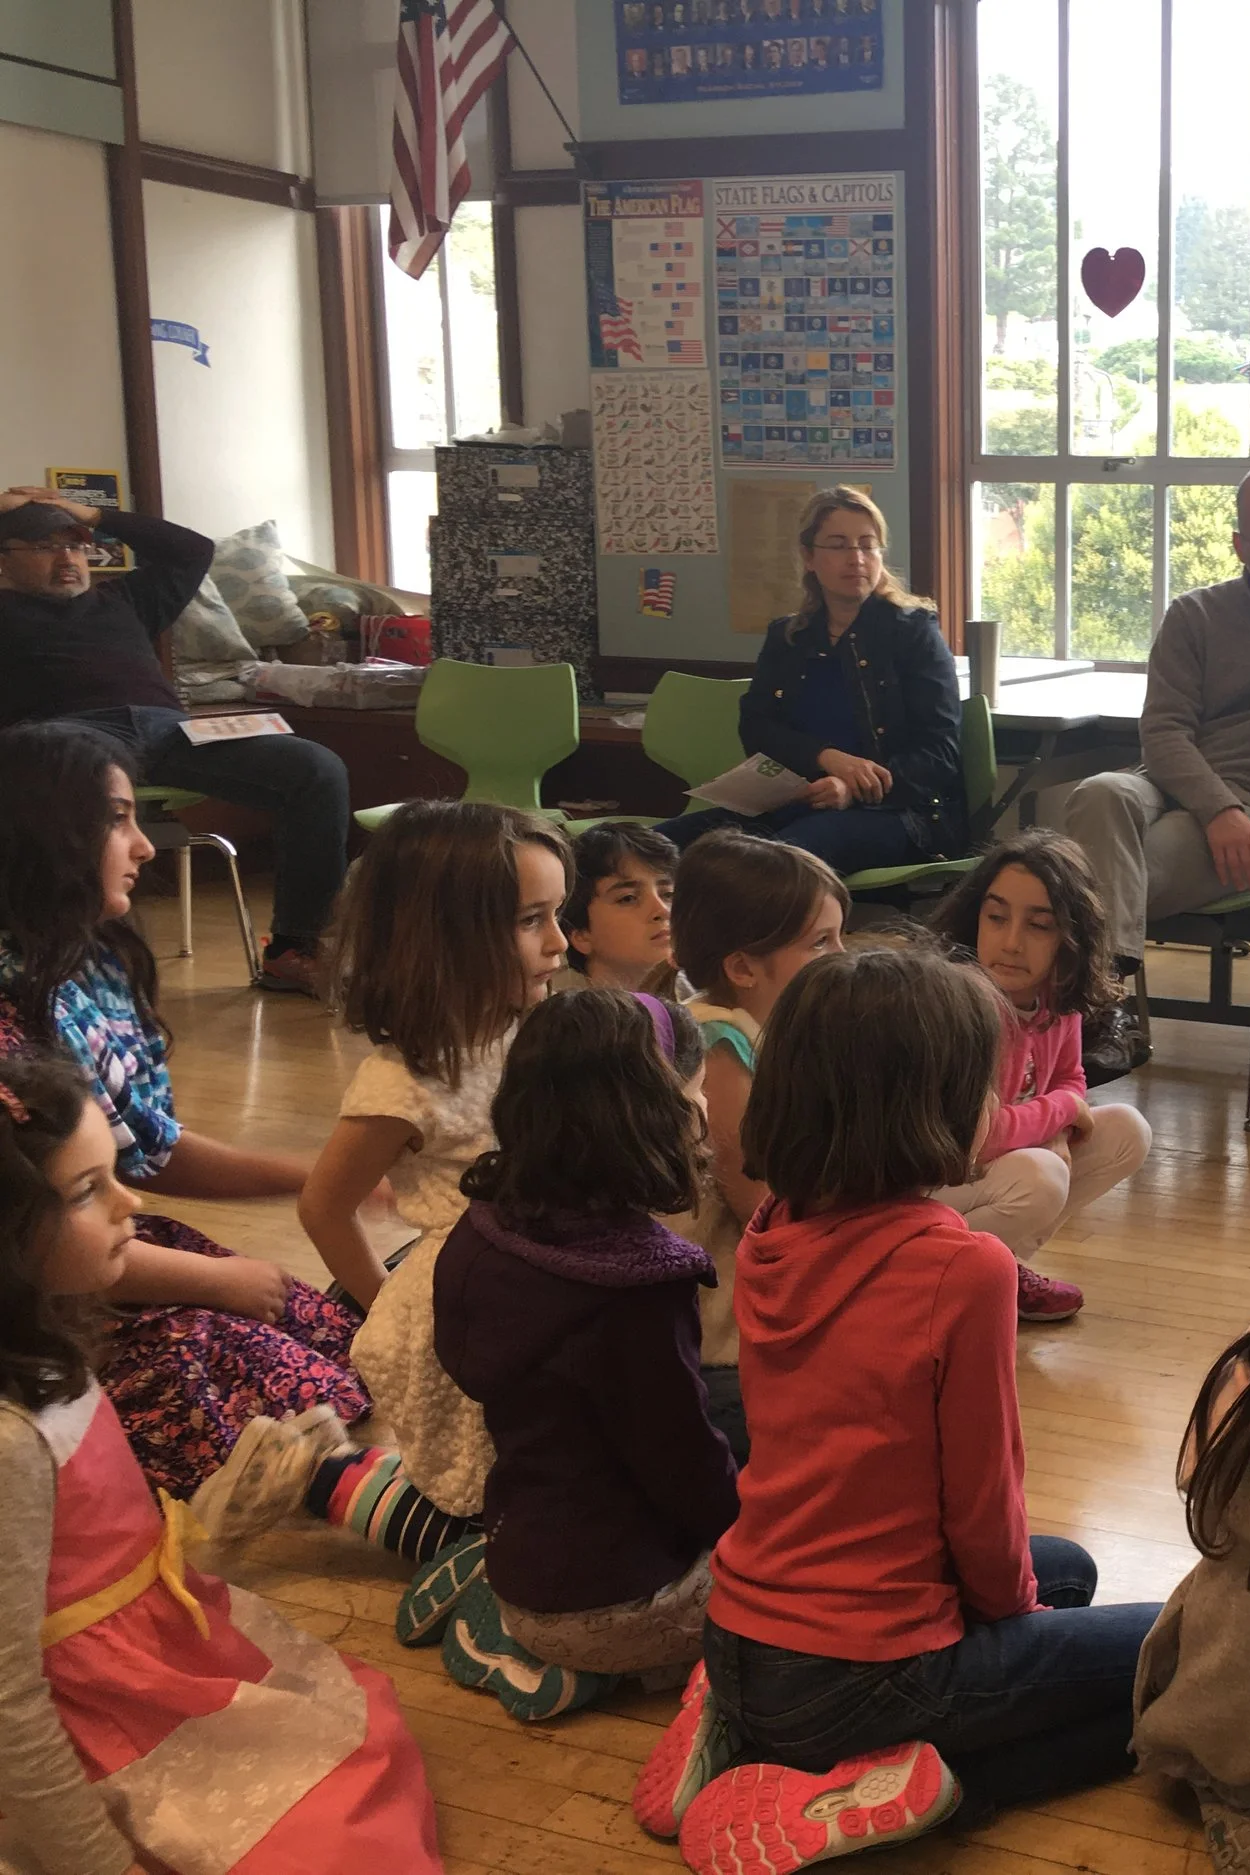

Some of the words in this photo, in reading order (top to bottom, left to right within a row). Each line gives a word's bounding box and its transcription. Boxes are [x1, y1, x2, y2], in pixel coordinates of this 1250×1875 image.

[588, 196, 612, 216] THE
[613, 196, 669, 215] AMERICAN
[670, 194, 701, 214] FLAG
[716, 187, 758, 206] STATE
[762, 185, 805, 205] FLAGS
[807, 186, 818, 204] &
[821, 183, 894, 203] CAPITOLS
